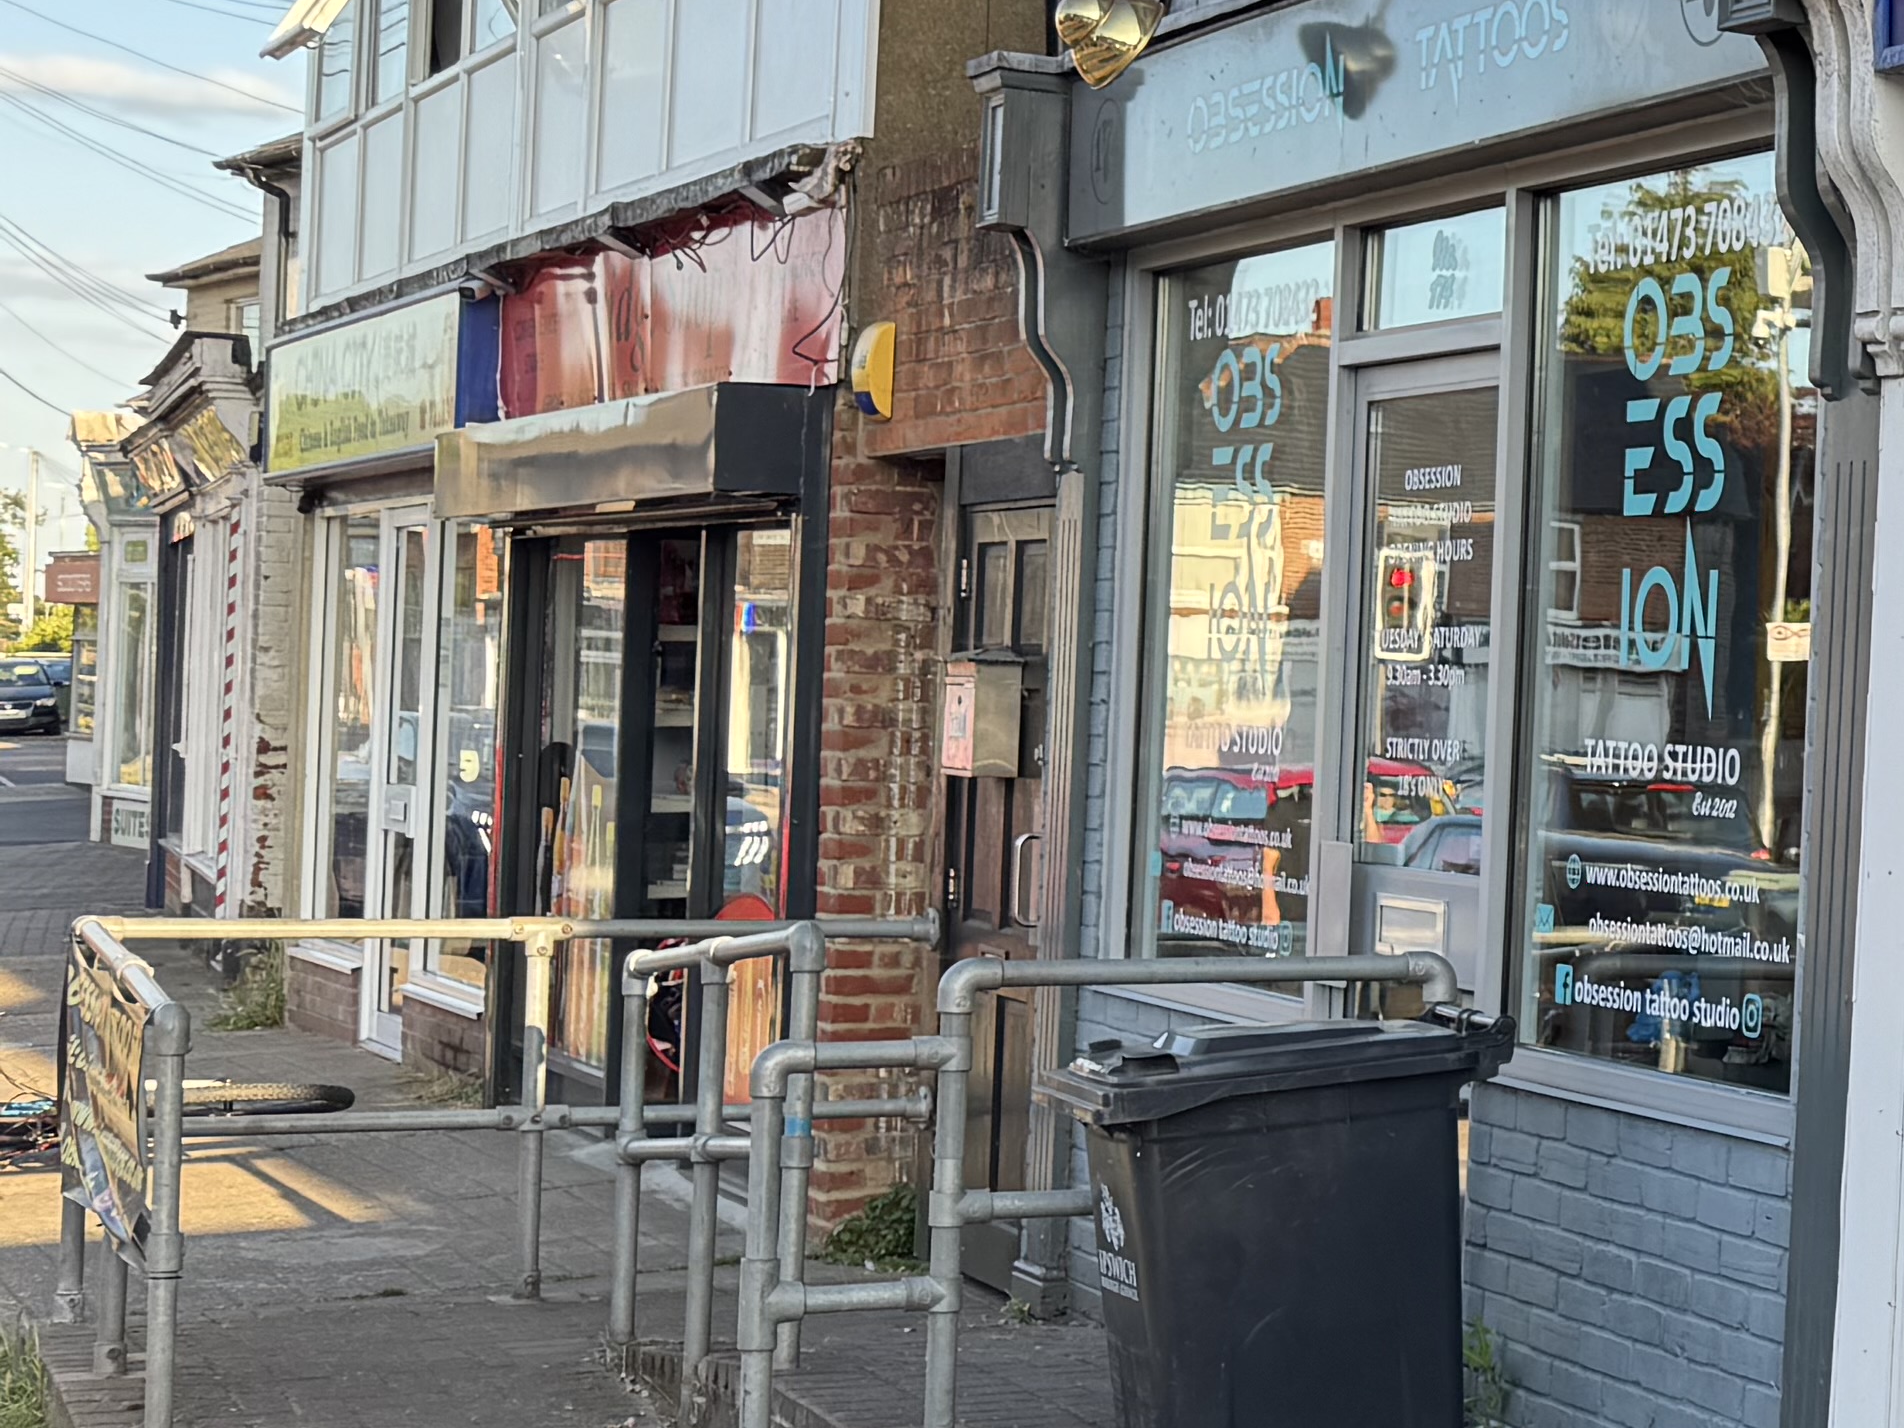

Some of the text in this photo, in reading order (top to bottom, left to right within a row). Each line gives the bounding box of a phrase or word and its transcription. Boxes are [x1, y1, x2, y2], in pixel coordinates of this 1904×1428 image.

[1187, 30, 1345, 153] OBSESSION
[1629, 205, 1696, 268] 01473
[1188, 294, 1212, 341] Tel:
[1215, 289, 1261, 336] 01473
[1624, 266, 1734, 381] OBS
[1211, 342, 1282, 433] OBS
[1405, 464, 1462, 490] OBSESSION
[1623, 392, 1724, 516] ESS
[1211, 442, 1274, 542] ESS
[1437, 539, 1473, 563] HOURS
[1619, 515, 1720, 722] ION
[1233, 725, 1283, 756] STUDIO
[1385, 737, 1429, 760] STRICTLY
[1585, 739, 1741, 785] TATTOO STUDIO
[1712, 797, 1737, 819] 2012
[1585, 864, 1760, 904] www.obsessiontattoos.co.uk
[1174, 907, 1279, 950] obsession tattoo studio
[1589, 912, 1790, 964] obsessiontattoos@hotmail.co.uk
[1575, 975, 1740, 1030] obsession tattoo studio
[1099, 1249, 1137, 1287] IPSWICH
